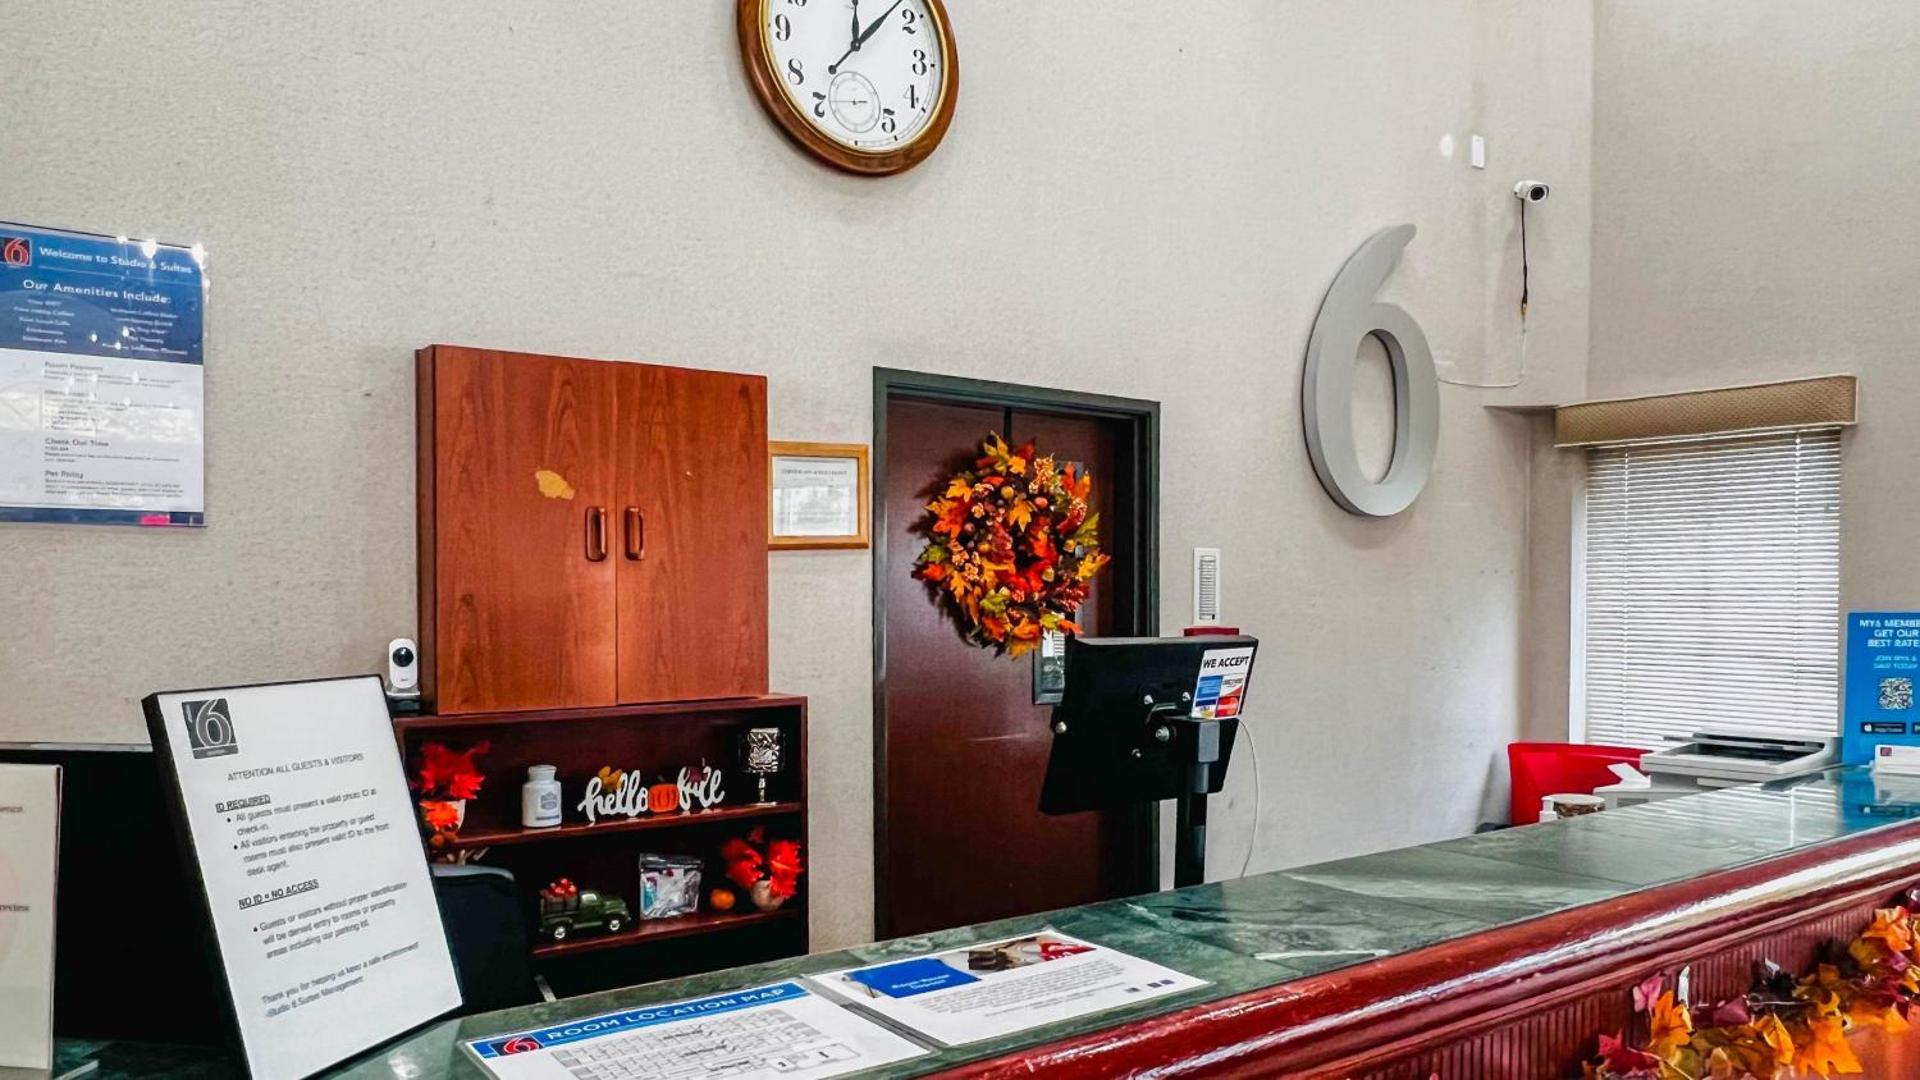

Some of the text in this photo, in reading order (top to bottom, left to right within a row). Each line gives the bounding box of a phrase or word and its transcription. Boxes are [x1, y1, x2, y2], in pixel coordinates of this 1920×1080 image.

[775, 14, 791, 41] 9
[902, 9, 916, 34] 2
[788, 58, 804, 85] 8
[912, 49, 927, 76] 3
[813, 92, 826, 118] 7
[904, 85, 919, 109] 4
[882, 108, 895, 133] 5
[5, 237, 29, 266] 6
[40, 247, 93, 262] Welcome
[95, 255, 108, 264] to
[111, 255, 147, 268] Studio
[160, 262, 192, 274] Suites
[23, 279, 171, 304] Our Amenities Include:
[1302, 224, 1440, 517] 6
[1867, 639, 1891, 647] BEST
[1874, 629, 1919, 638] GET OUR
[1203, 656, 1249, 669] WE ACCEPT
[196, 698, 231, 748] 6
[228, 753, 364, 781] ATTENTION ALL GUESTS & VISITORS
[216, 794, 271, 813] ID REQUIRED
[577, 770, 648, 822] hello
[239, 897, 252, 908] NO
[253, 894, 262, 905] ID
[271, 888, 284, 899] NO
[286, 879, 319, 895] ACCESS
[547, 988, 785, 1040] ROOM LOCATION MAP
[503, 1037, 540, 1055] 6
